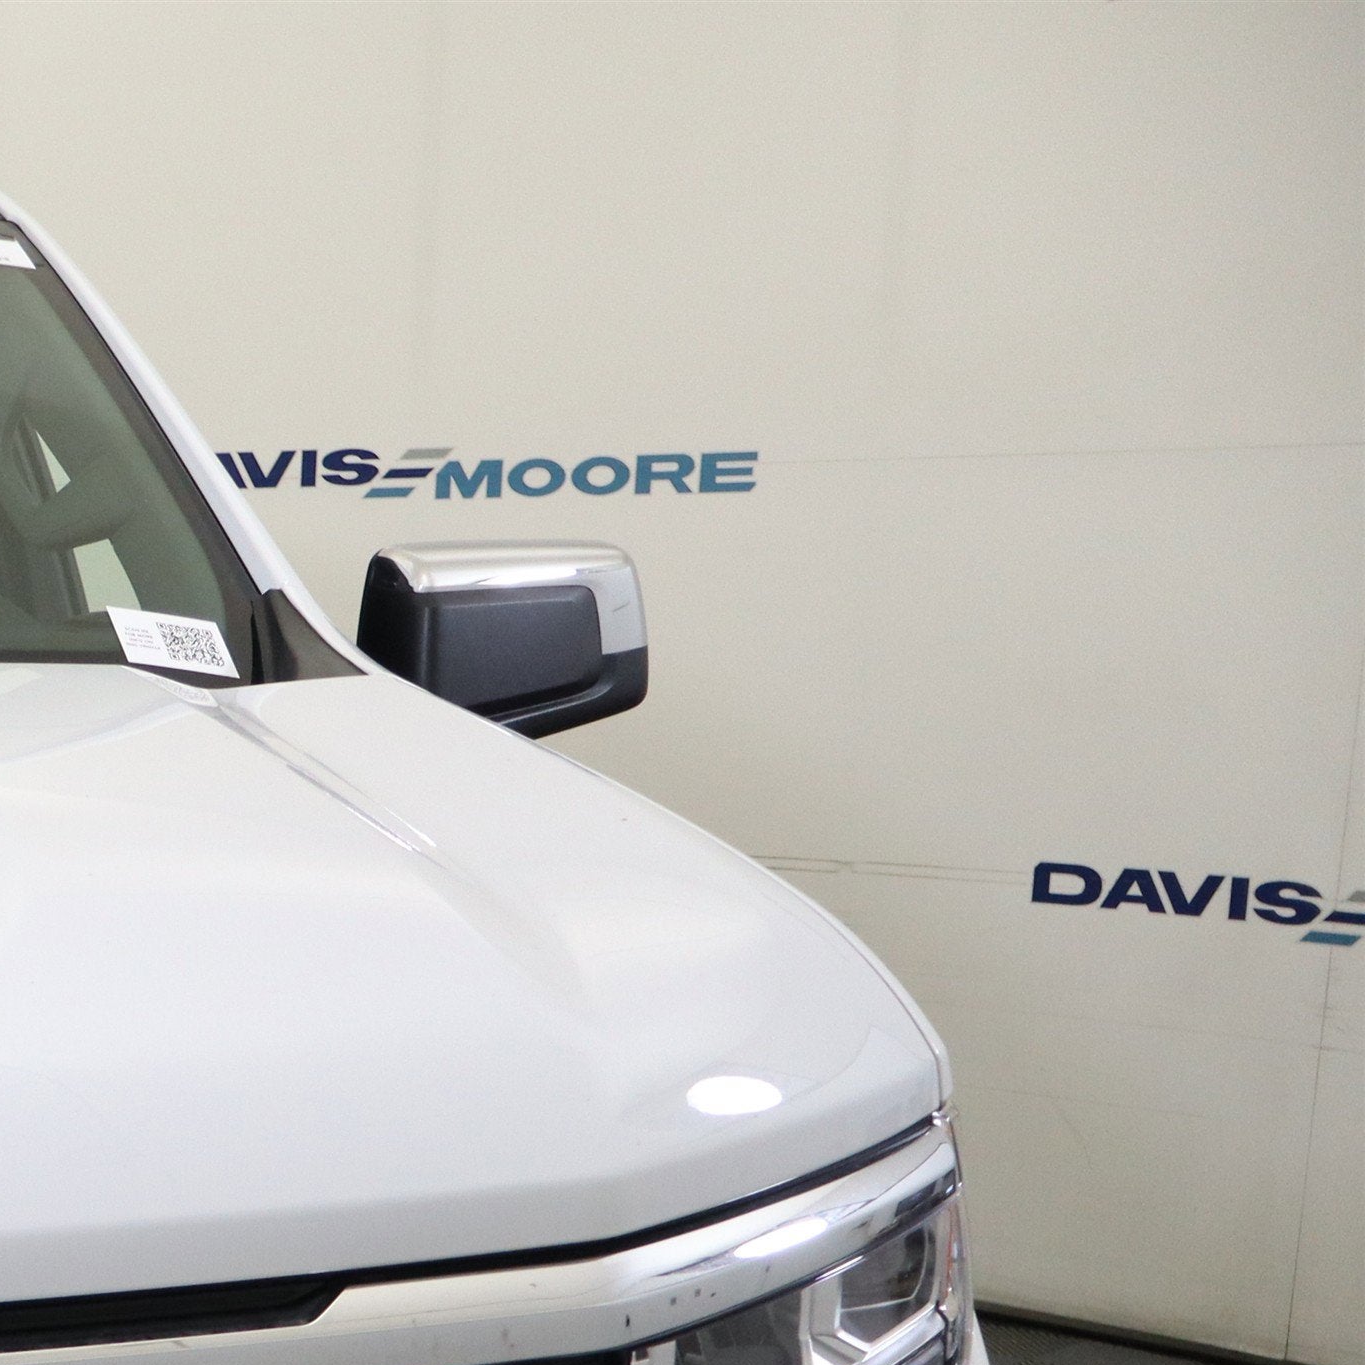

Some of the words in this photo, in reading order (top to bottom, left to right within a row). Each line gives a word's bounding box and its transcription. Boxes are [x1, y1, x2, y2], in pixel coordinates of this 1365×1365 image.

[215, 448, 379, 488] VIS
[435, 451, 759, 499] MOORE
[1031, 861, 1323, 925] DAVIS
